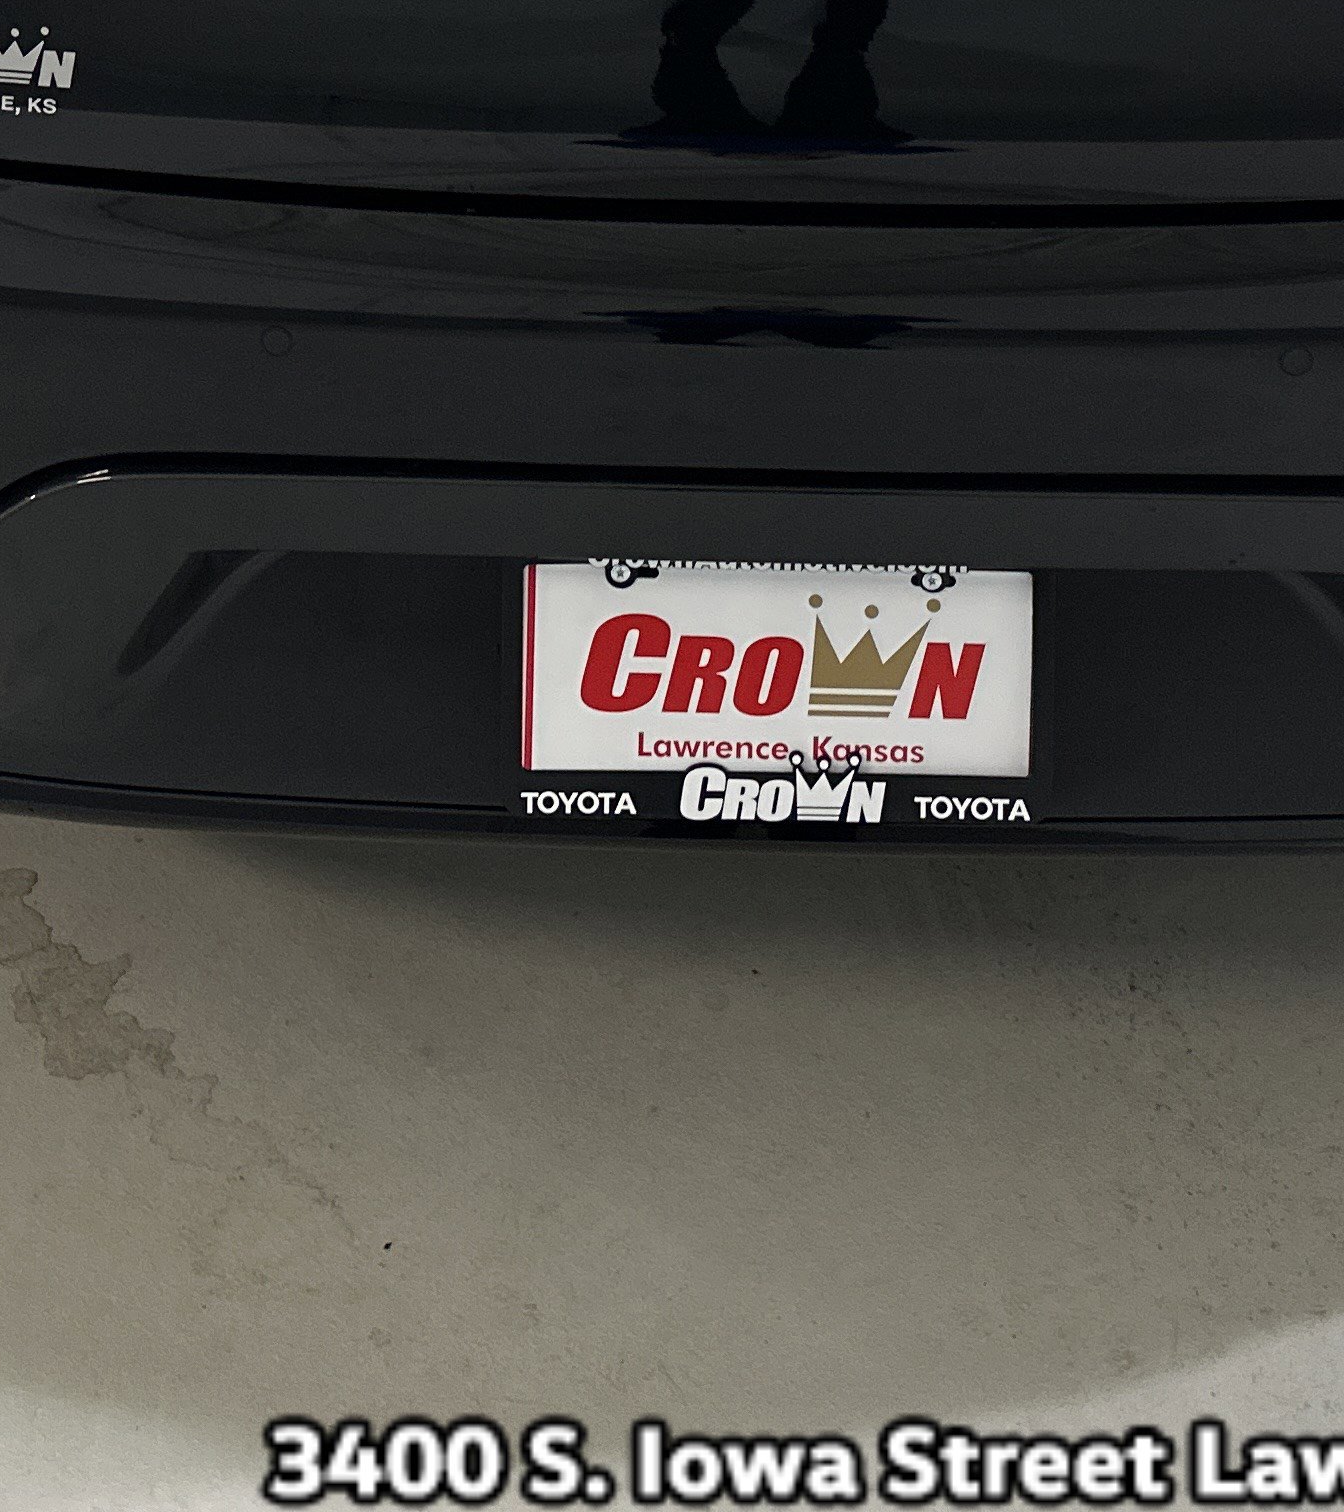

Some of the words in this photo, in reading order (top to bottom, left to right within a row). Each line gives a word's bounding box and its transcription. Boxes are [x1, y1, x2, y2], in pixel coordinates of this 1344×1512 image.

[27, 96, 58, 116] KS
[812, 735, 925, 764] Kansas
[520, 790, 637, 816] TOYOTA
[913, 795, 1031, 823] TOYOTA
